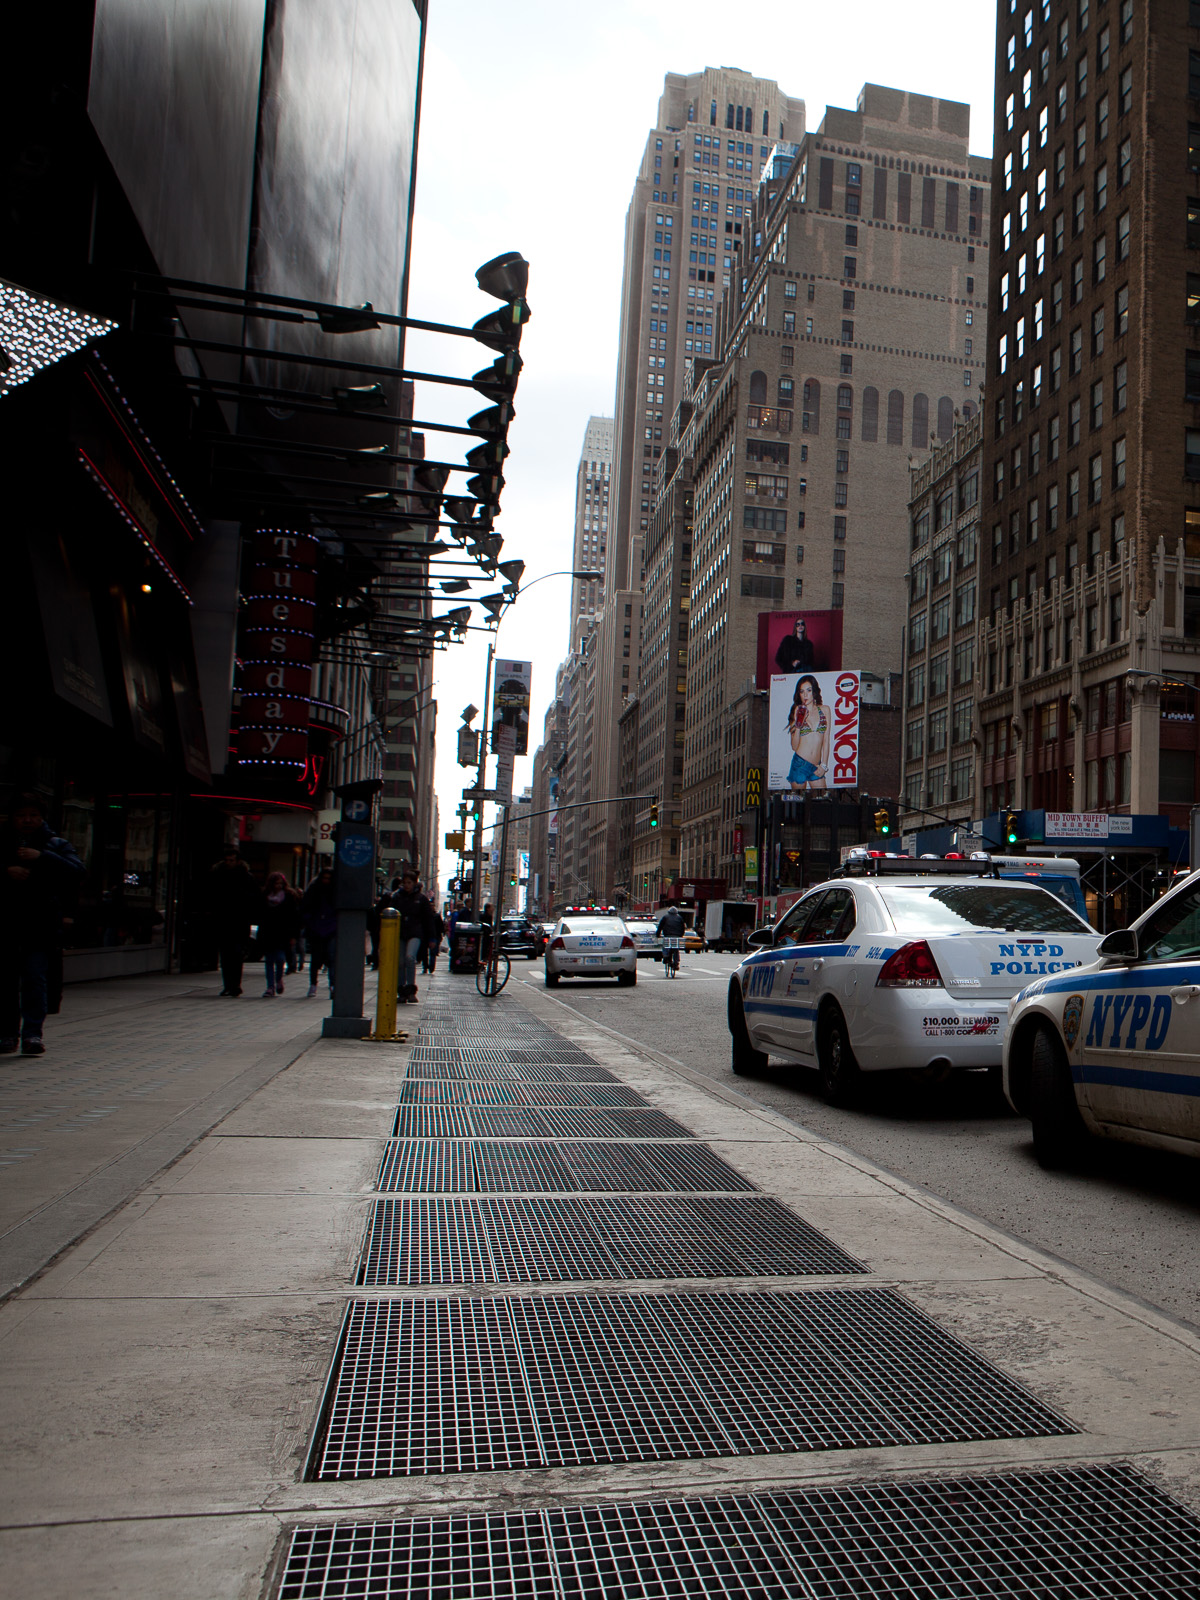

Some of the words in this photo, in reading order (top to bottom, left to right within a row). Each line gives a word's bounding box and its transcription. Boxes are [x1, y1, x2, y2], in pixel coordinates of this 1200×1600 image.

[260, 536, 297, 754] Tuesday
[498, 694, 526, 705] SPY
[834, 673, 859, 784] BONGO
[1047, 813, 1060, 822] MID
[1062, 813, 1081, 822] TOWN
[1083, 814, 1107, 823] BUFFET
[999, 944, 1064, 957] NYPD
[990, 961, 1075, 975] POLICE
[749, 966, 776, 998] NYPD
[923, 1016, 960, 1026] $10,000
[962, 1016, 1000, 1025] REWARD
[1085, 994, 1172, 1051] NYPD
